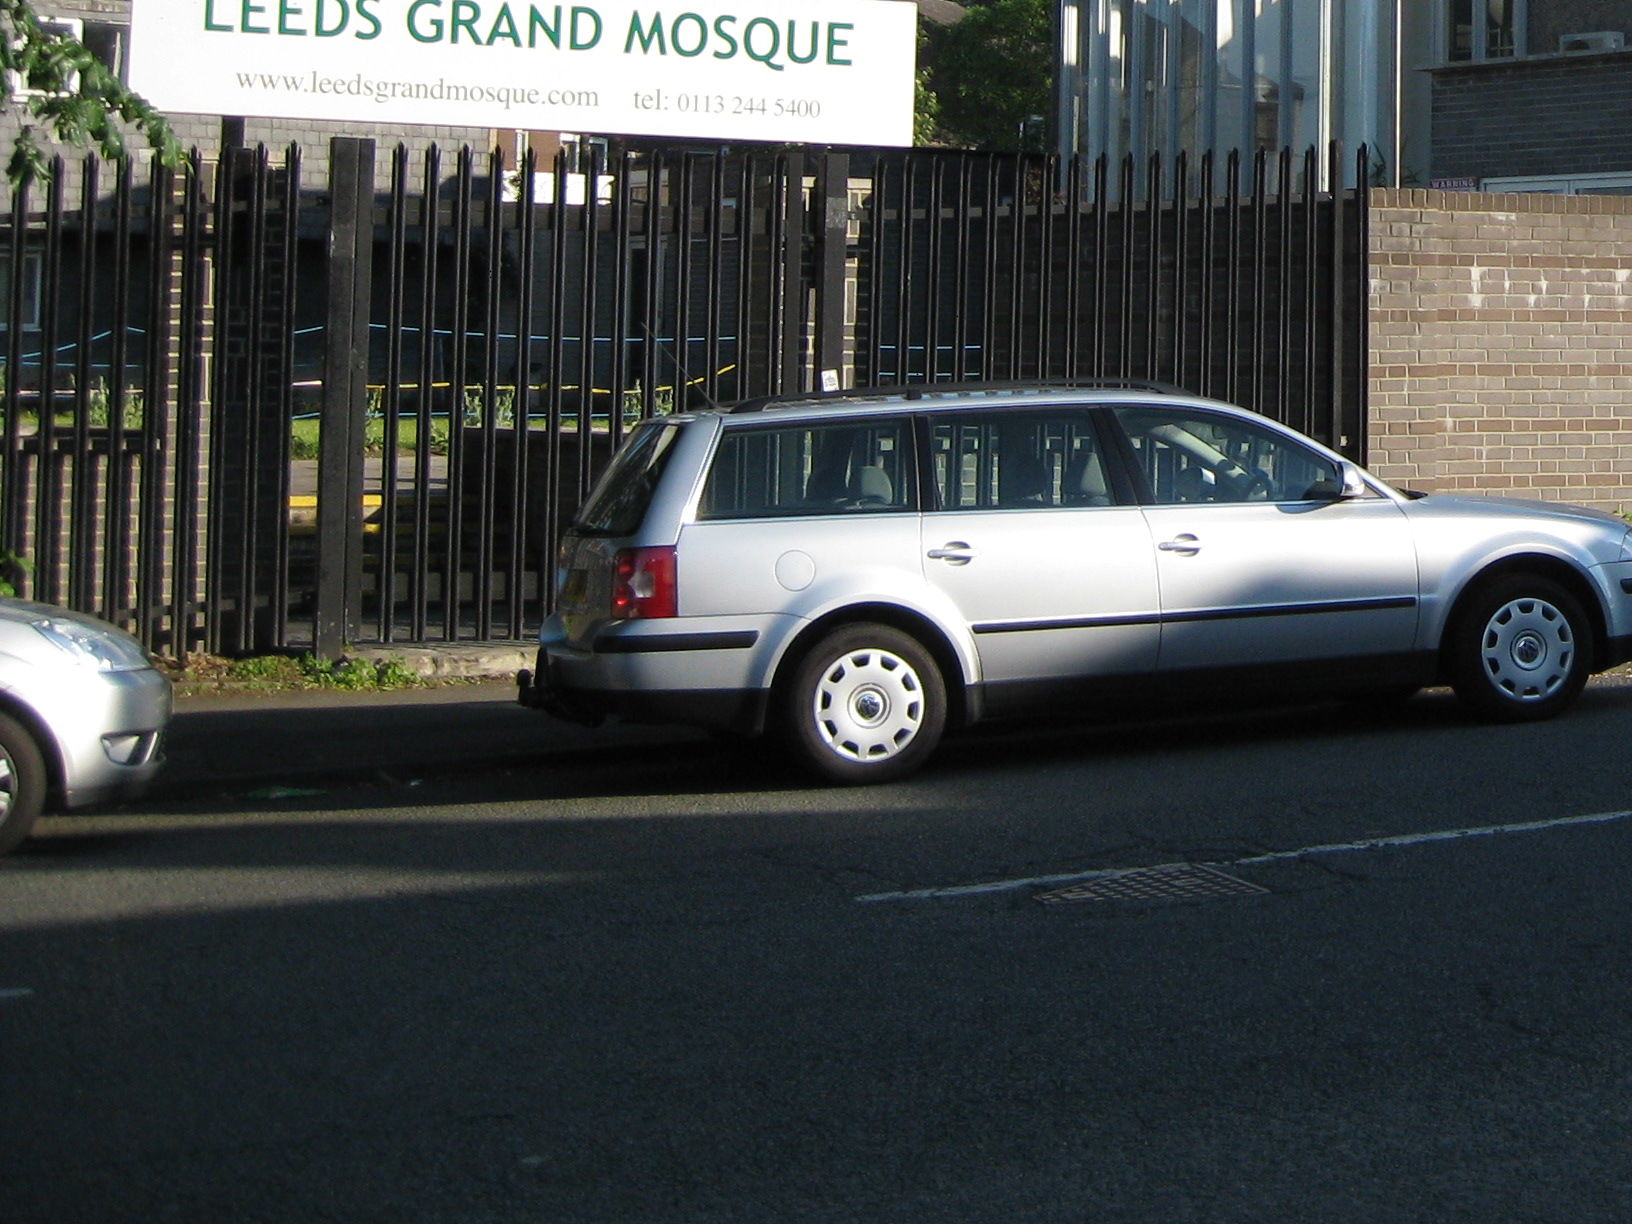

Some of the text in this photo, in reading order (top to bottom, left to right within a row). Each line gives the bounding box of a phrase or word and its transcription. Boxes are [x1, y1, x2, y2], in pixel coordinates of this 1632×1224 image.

[624, 9, 855, 71] MOSQUE
[235, 70, 822, 119] www.leedsgrandmosque.com tel: 0113 244 5400
[1431, 178, 1475, 189] WARNING
